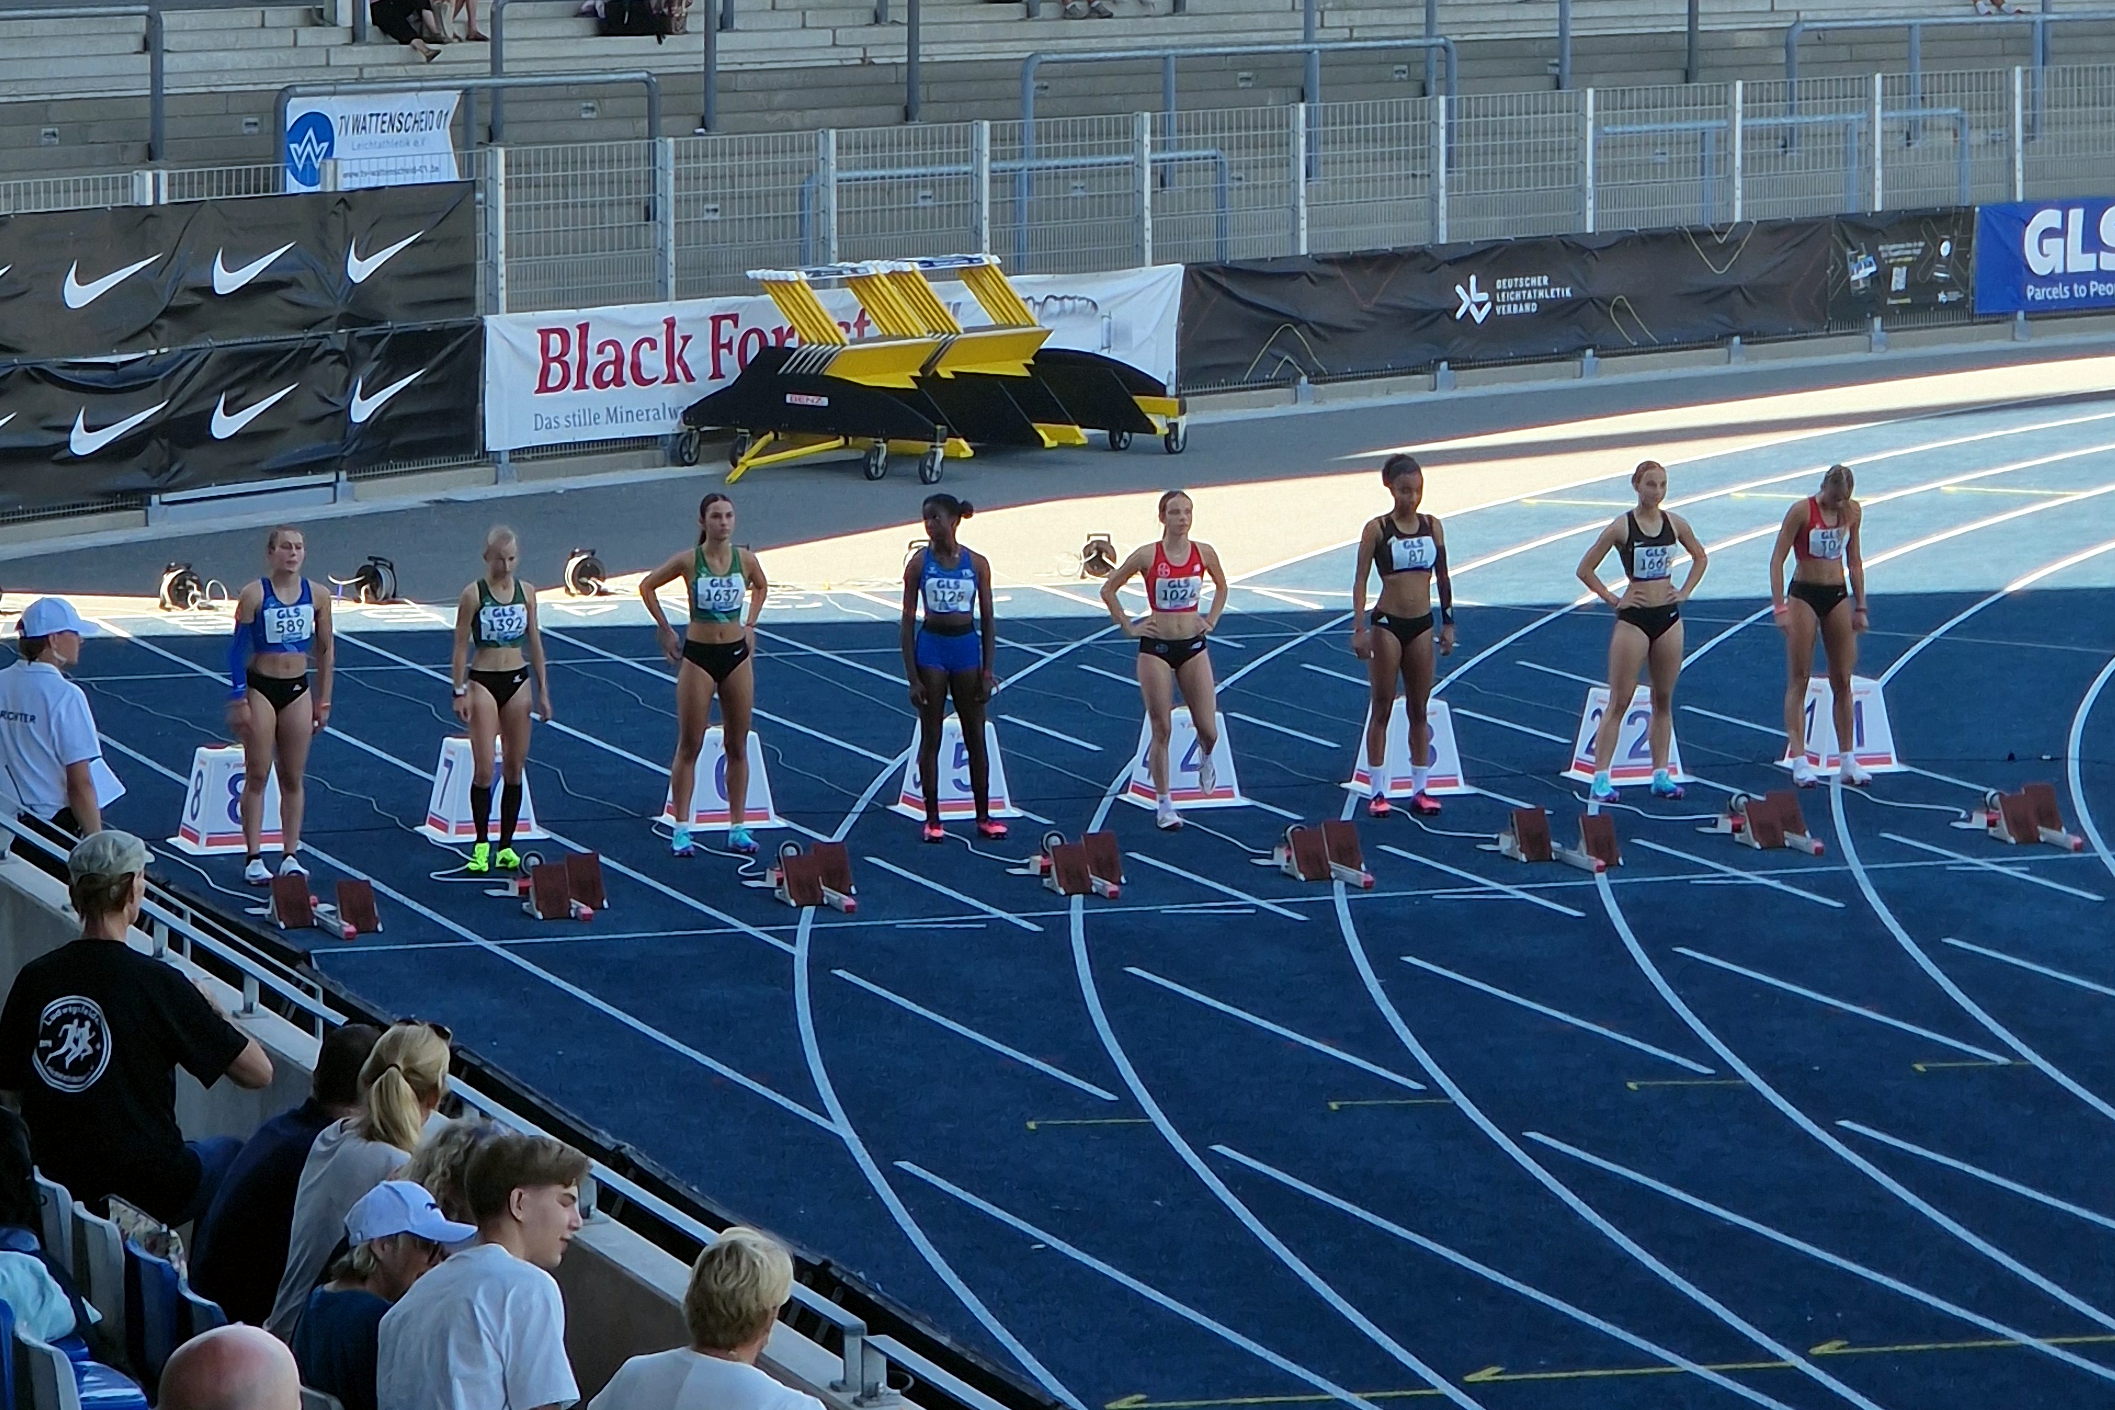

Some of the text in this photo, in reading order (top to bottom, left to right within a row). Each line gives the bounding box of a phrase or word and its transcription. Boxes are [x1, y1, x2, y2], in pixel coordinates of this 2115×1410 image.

[339, 109, 450, 137] TV WATTENSCHEID 01
[1496, 275, 1549, 290] DEUTSCHER
[1496, 287, 1572, 303] LEICHTATHLETIK
[2027, 280, 2115, 301] Parcels to Peo
[1495, 302, 1538, 316] VERBAND
[534, 307, 871, 394] Black Fort
[533, 413, 560, 432] Das
[564, 408, 600, 428] stille
[1402, 539, 1424, 549] GLS
[1409, 549, 1424, 563] 87
[1645, 548, 1667, 557] GLS
[709, 579, 733, 588] GLS
[936, 579, 960, 590] GLS
[1167, 579, 1190, 588] GLS
[705, 589, 739, 602] 1637
[932, 590, 965, 602] 1125
[277, 608, 300, 619] GLS
[492, 607, 516, 618] GLS
[275, 618, 305, 634] 589
[489, 617, 522, 631] 1392
[1626, 709, 1653, 760] 2
[439, 757, 454, 810] 7
[190, 769, 204, 822] 8
